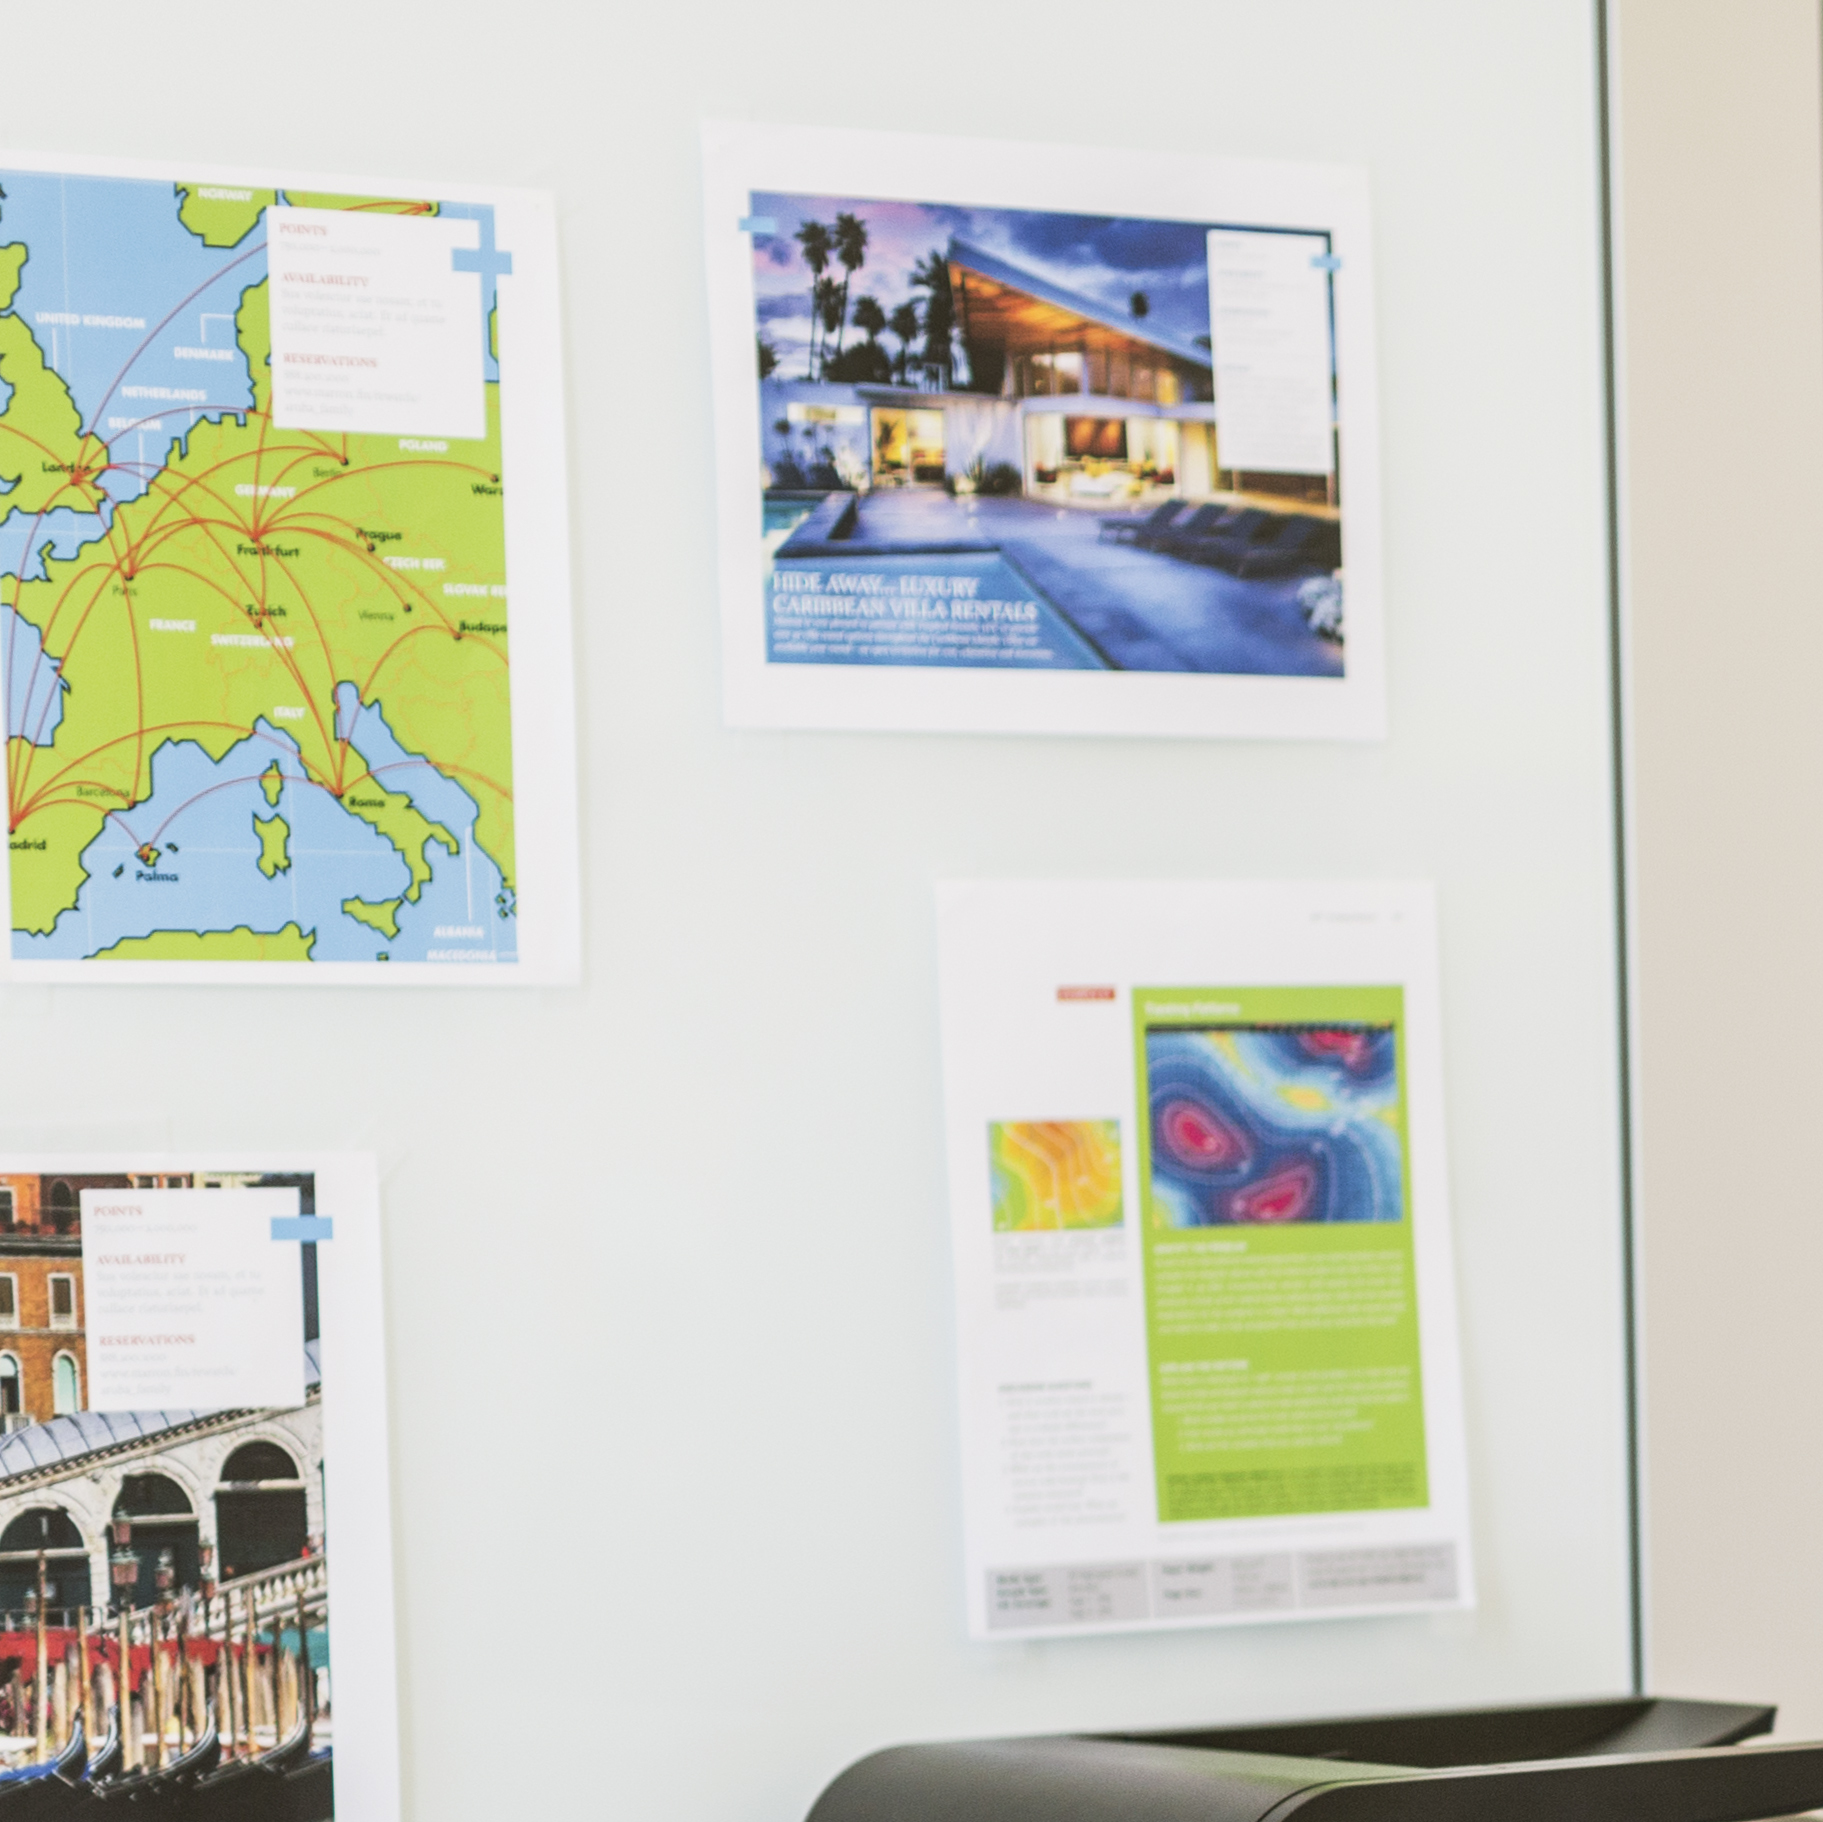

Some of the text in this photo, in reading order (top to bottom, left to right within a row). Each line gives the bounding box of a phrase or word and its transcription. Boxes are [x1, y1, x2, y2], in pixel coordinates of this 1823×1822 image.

[198, 187, 252, 201] NORWAY
[279, 222, 327, 236] POINTS
[281, 272, 369, 287] AVAILABILITY
[36, 312, 145, 328] UNITED KINGDOM
[174, 347, 234, 361] DENMARK
[283, 353, 377, 368] RESERVATIONS
[121, 386, 207, 401] NETHERLANDS
[398, 439, 448, 452] POLAND
[356, 528, 402, 542] Prague
[773, 571, 822, 592] HIDE
[900, 575, 980, 597] LUXURY
[773, 594, 1037, 621] CARIBBEAN VILLA RENTALS
[149, 618, 196, 632] FRANCE
[274, 706, 305, 719] ITALY
[136, 871, 179, 883] Palma
[93, 1205, 143, 1217] POINTS
[96, 1253, 187, 1265] AVAILABILITY
[99, 1334, 196, 1346] RESERVATIONS
